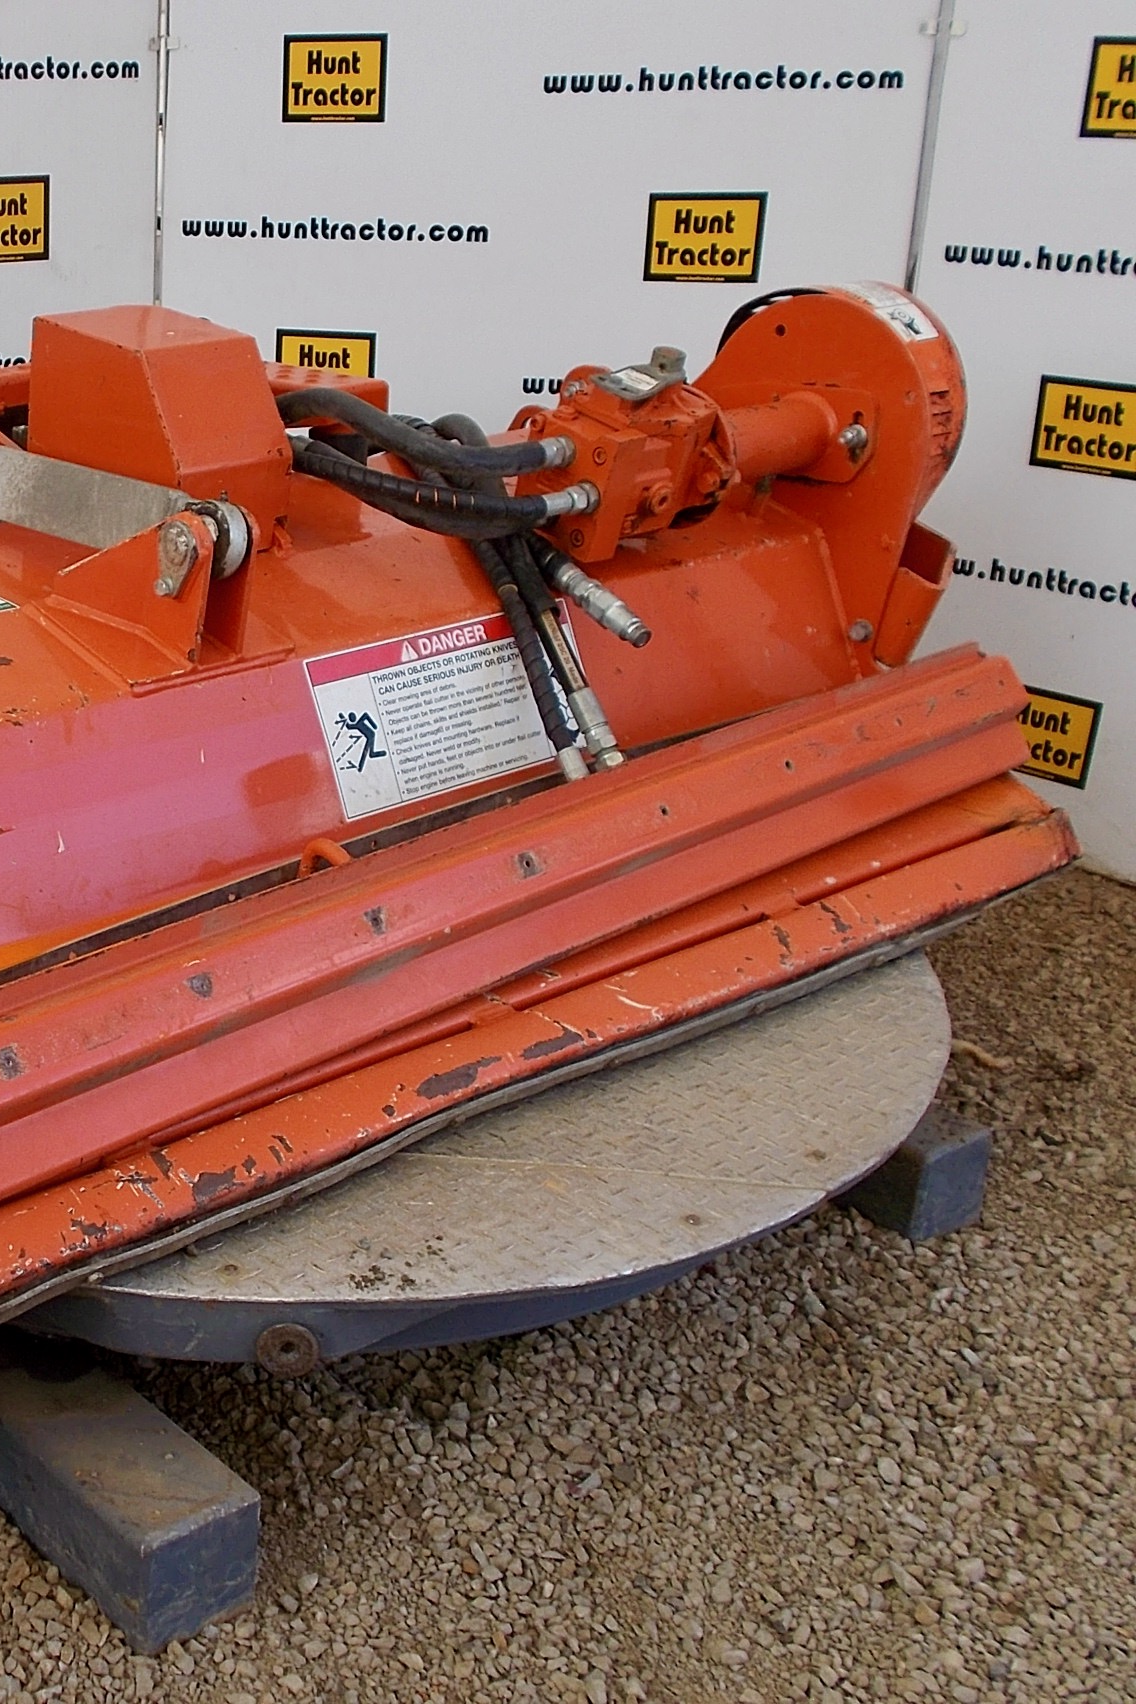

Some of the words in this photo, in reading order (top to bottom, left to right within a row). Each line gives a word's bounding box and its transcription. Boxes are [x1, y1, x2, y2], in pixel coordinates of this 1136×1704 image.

[307, 50, 360, 75] Hunt
[543, 65, 904, 94] www.hunttractor.com
[291, 82, 376, 107] Tractor
[182, 216, 489, 243] www.hunttractor.com
[673, 208, 735, 234] Hunt
[655, 241, 751, 268] Tractor
[944, 245, 1136, 276] www.hunttr
[299, 344, 350, 369] Hunt
[1063, 393, 1125, 426] Hunt
[1043, 424, 1136, 462] Tractor
[417, 623, 487, 655] DANGER
[371, 668, 406, 684] THROWN
[406, 659, 441, 675] OBJECTS
[441, 656, 454, 666] OR
[454, 647, 491, 663] ROTATING
[491, 640, 518, 653] KNIVES
[377, 683, 395, 695] CAN
[395, 677, 422, 690] CAUSE
[422, 668, 456, 683] SERIOUS
[456, 661, 483, 674] INJURY
[483, 657, 496, 668] OR
[496, 651, 520, 664] DEATH
[385, 707, 401, 716] Never
[397, 692, 419, 704] mowing
[387, 714, 409, 727] Objects
[428, 705, 447, 714] thrown
[431, 737, 442, 745] and
[442, 730, 468, 743] mounting
[1027, 739, 1082, 770] ctor
[419, 770, 437, 780] engine
